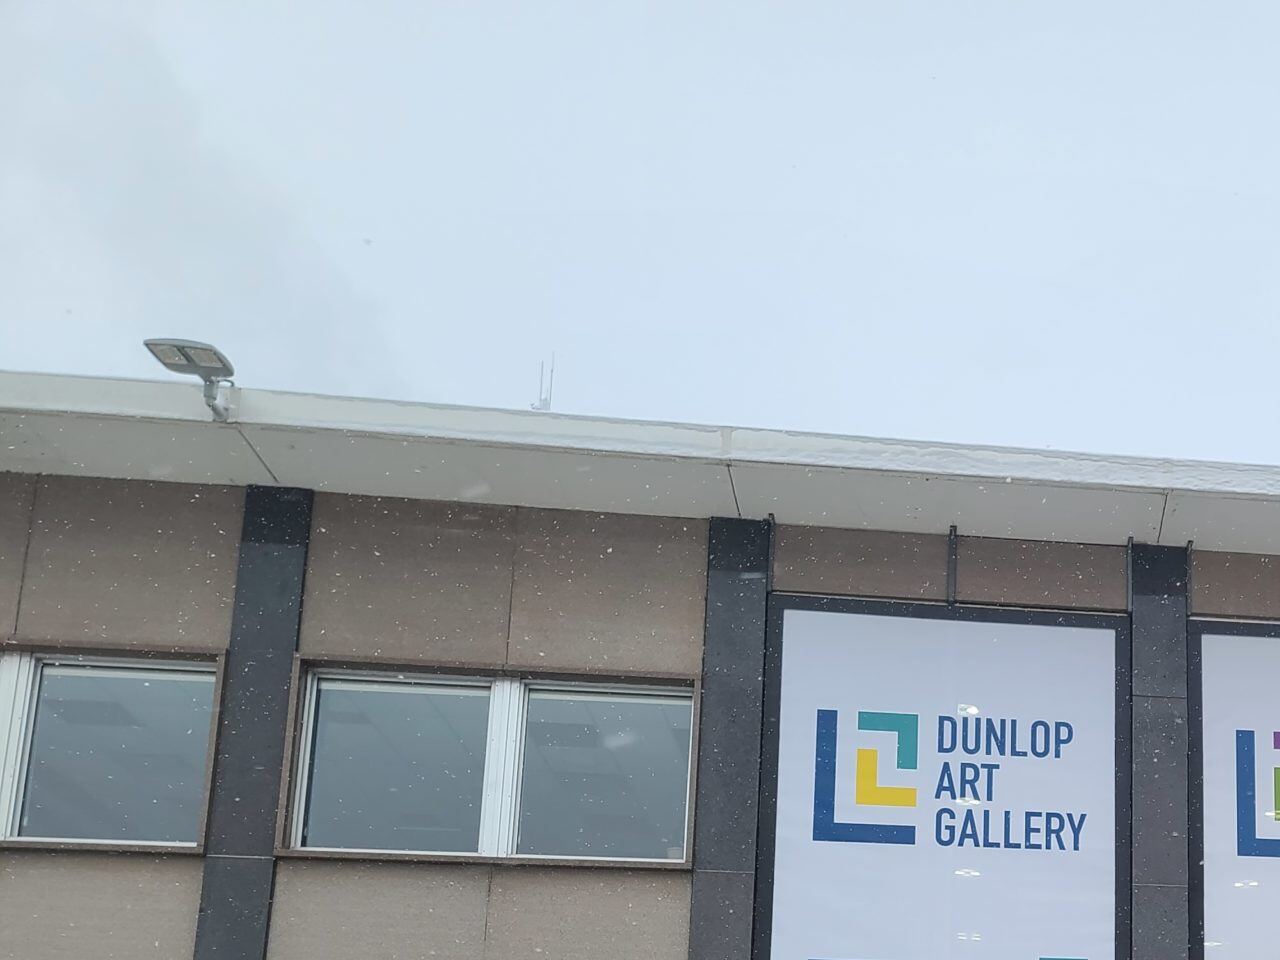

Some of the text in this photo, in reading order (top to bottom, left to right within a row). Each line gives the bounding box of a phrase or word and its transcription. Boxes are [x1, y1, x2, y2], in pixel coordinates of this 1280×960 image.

[937, 715, 1074, 758] DUNLOP
[935, 763, 1000, 802] ART
[935, 809, 1087, 852] GALLERY
